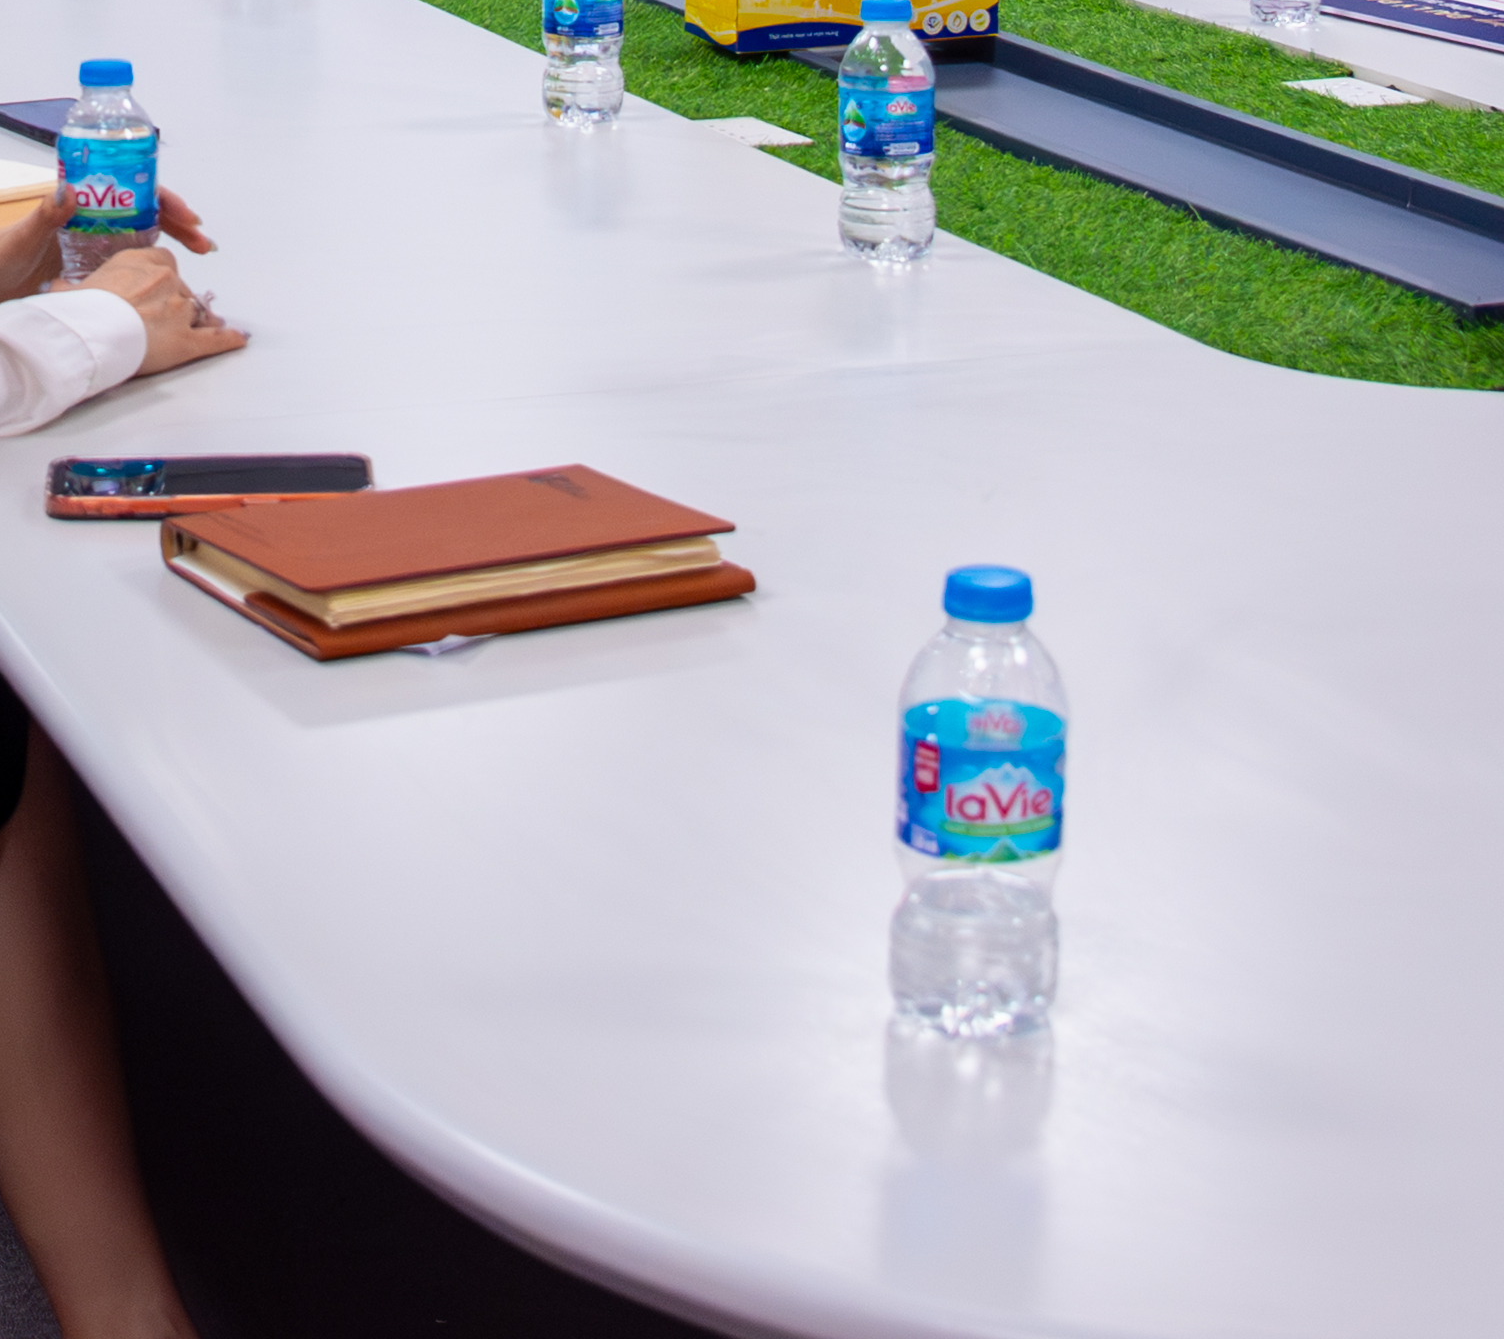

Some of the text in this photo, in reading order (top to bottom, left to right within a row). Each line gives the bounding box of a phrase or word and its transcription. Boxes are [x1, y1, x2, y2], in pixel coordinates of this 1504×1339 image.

[886, 100, 917, 115] laVie
[76, 183, 134, 208] aVie
[945, 782, 1052, 821] laVie
